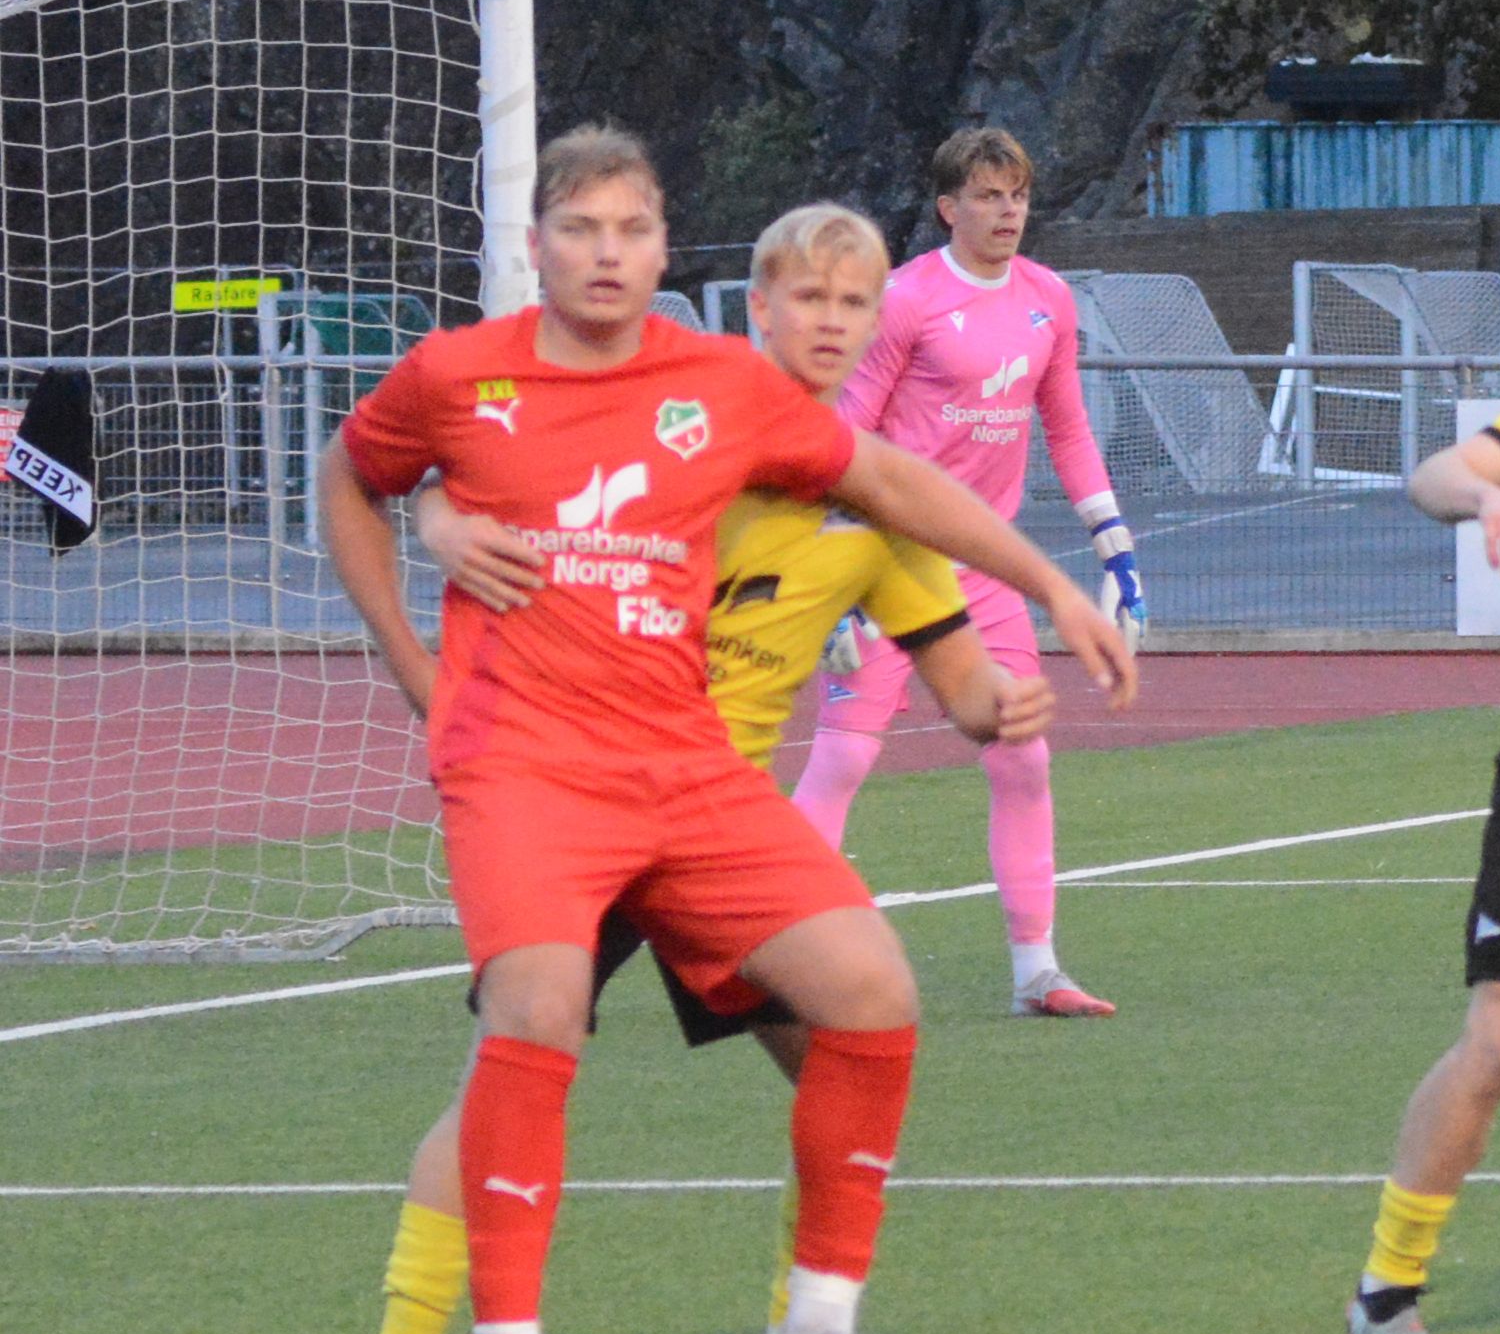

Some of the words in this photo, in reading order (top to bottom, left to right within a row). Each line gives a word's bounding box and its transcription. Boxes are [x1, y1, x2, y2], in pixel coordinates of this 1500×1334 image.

[971, 425, 1019, 444] Norge
[552, 553, 650, 592] Norge
[617, 595, 688, 636] Fibo
